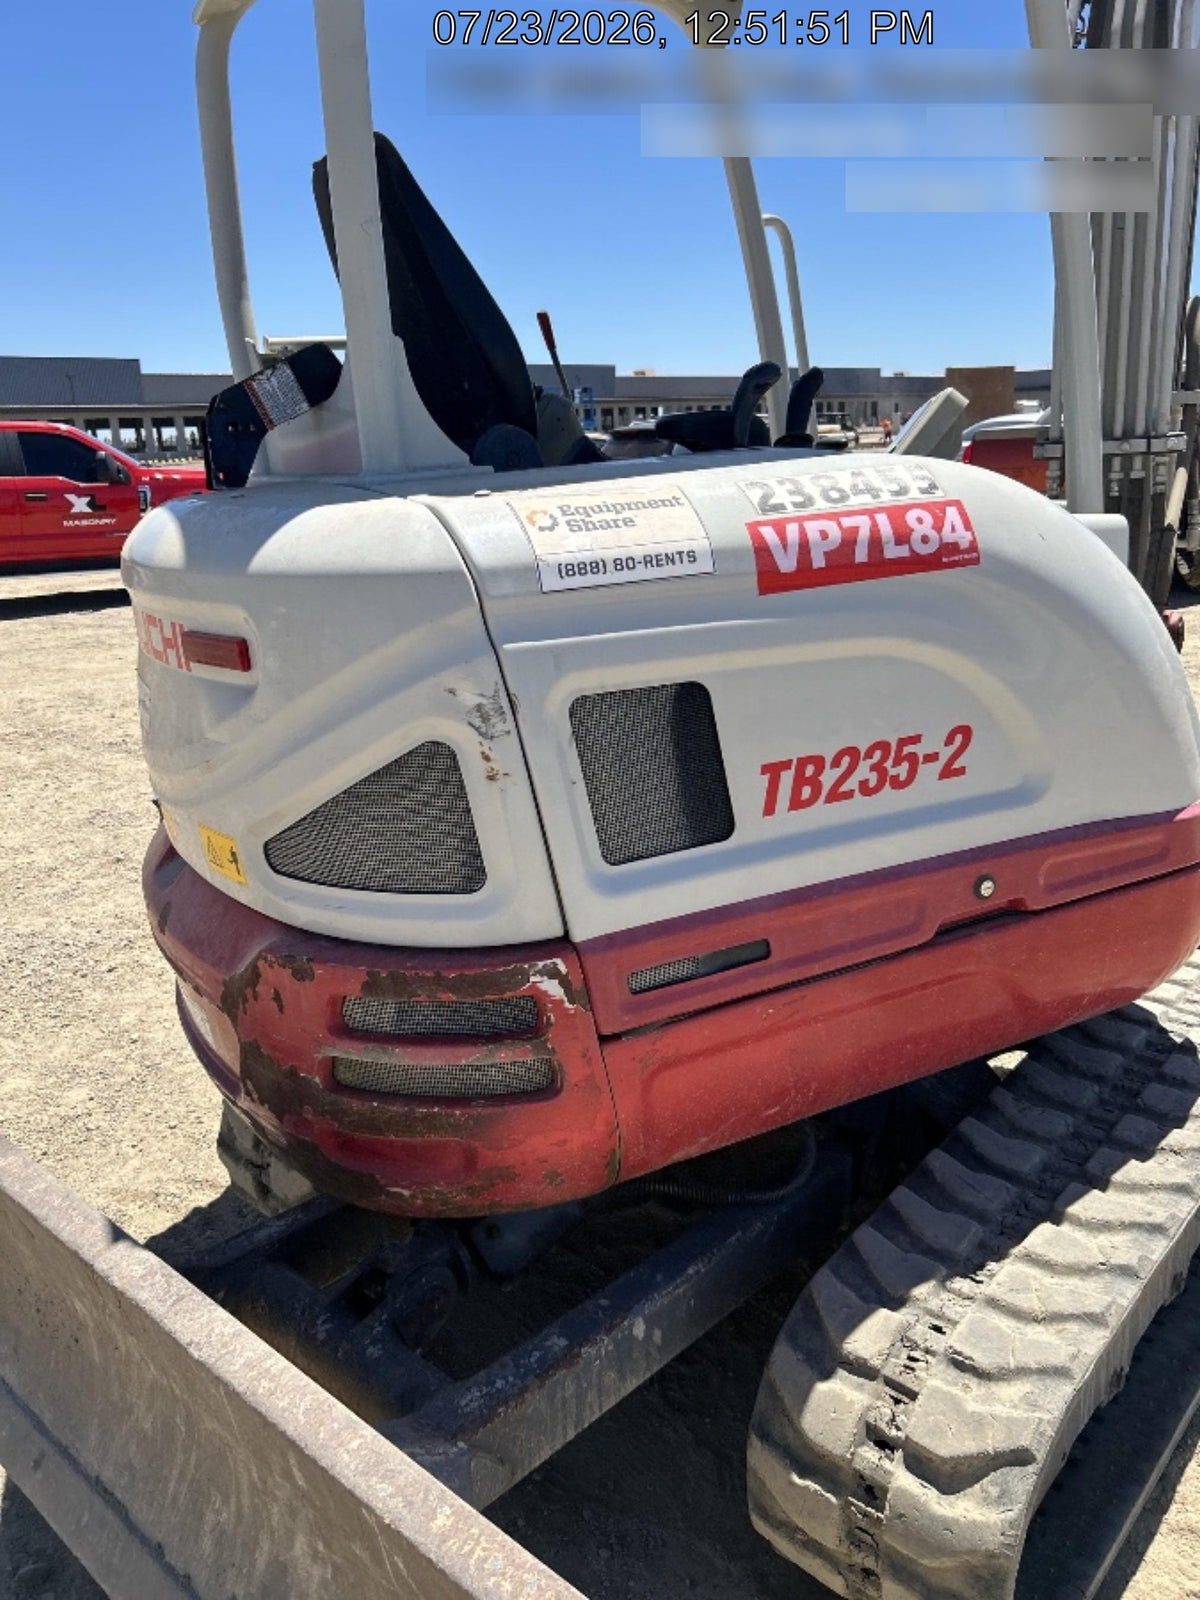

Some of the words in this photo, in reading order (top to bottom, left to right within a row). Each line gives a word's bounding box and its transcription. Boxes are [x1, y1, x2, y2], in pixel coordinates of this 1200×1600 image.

[558, 495, 685, 518] Equipment
[63, 518, 117, 527] MASONRY
[565, 516, 637, 533] Share
[758, 506, 974, 573] VP7L84
[558, 558, 607, 580] (888)
[613, 550, 698, 572] 80-RENTS
[760, 724, 973, 818] TB235-2
